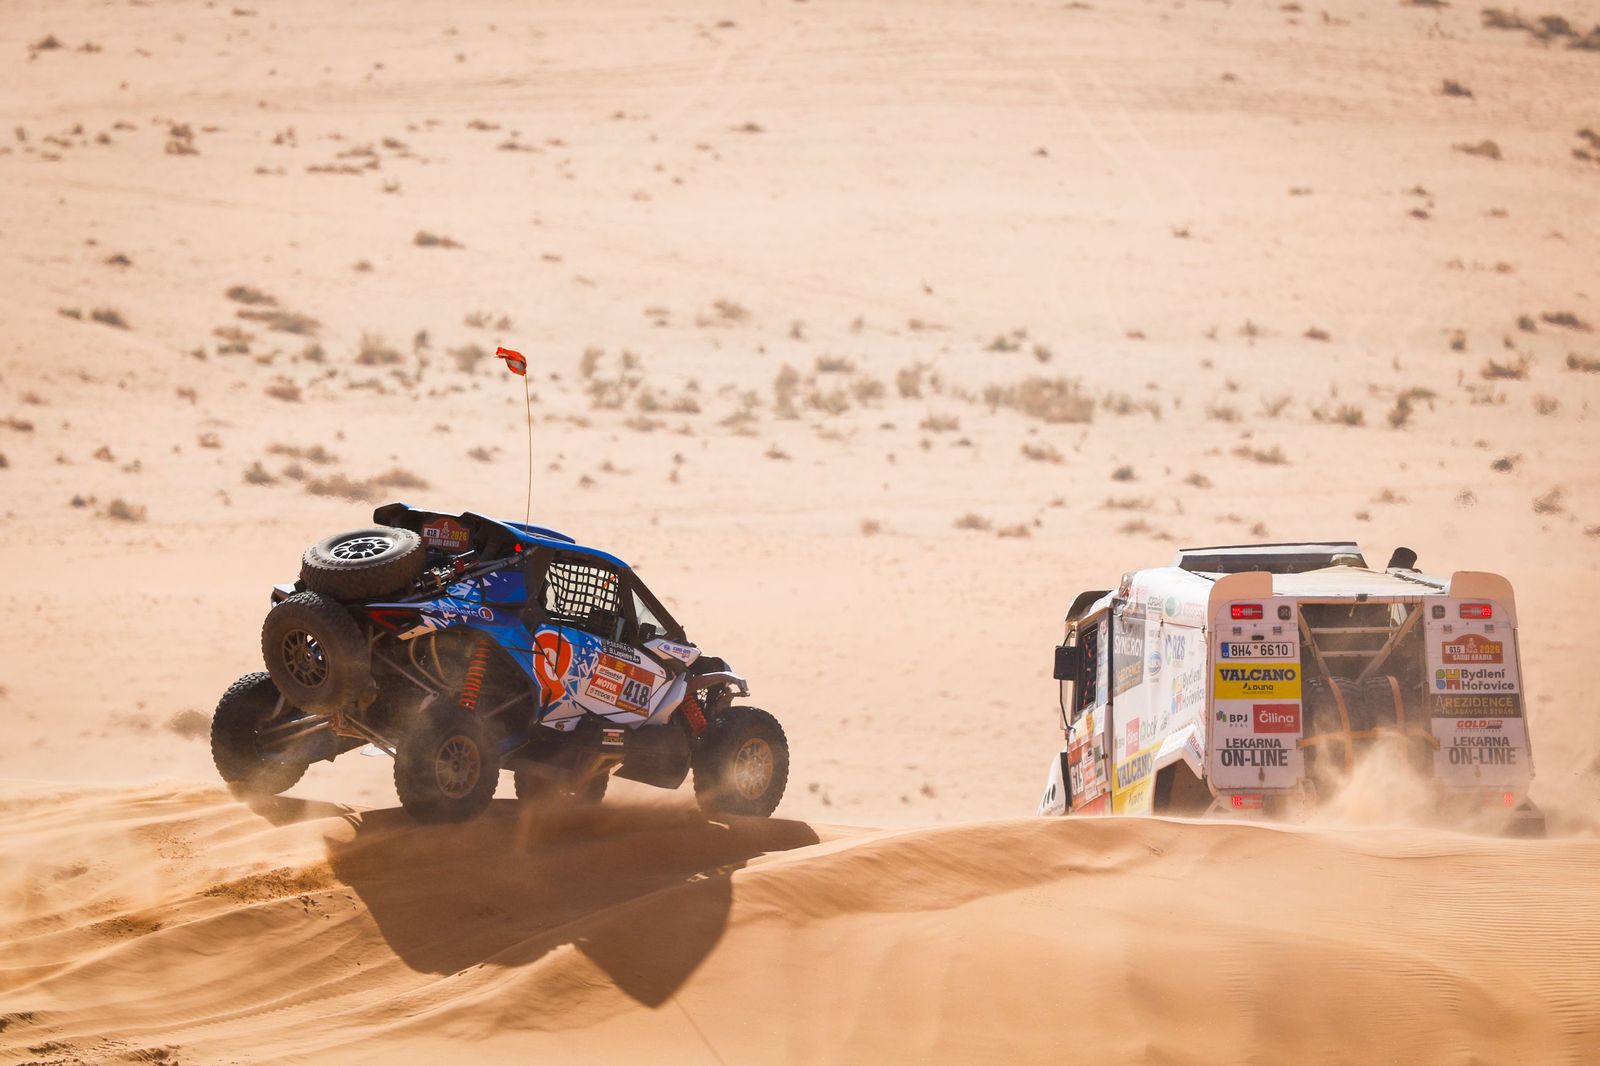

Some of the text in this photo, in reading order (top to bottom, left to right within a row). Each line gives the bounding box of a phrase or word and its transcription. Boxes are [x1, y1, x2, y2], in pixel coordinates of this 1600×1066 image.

[451, 530, 468, 541] 2026
[1231, 644, 1288, 656] 8H4 6610
[1480, 644, 1500, 654] 2026
[1219, 668, 1296, 681] VALCANO
[1461, 668, 1505, 681] Bydlení
[594, 677, 618, 692] MOTUL
[1461, 681, 1514, 690] Hořovice
[594, 689, 611, 700] TUDOR
[623, 680, 650, 707] 418
[1444, 697, 1513, 707] REZIDENCE
[1229, 714, 1248, 722] BPJ
[1259, 710, 1294, 723] Čilina
[1456, 720, 1488, 729] GOLD
[1221, 749, 1288, 767] ON-LINE
[1448, 748, 1517, 765] ON-LINE
[1117, 752, 1152, 788] VALCANO
